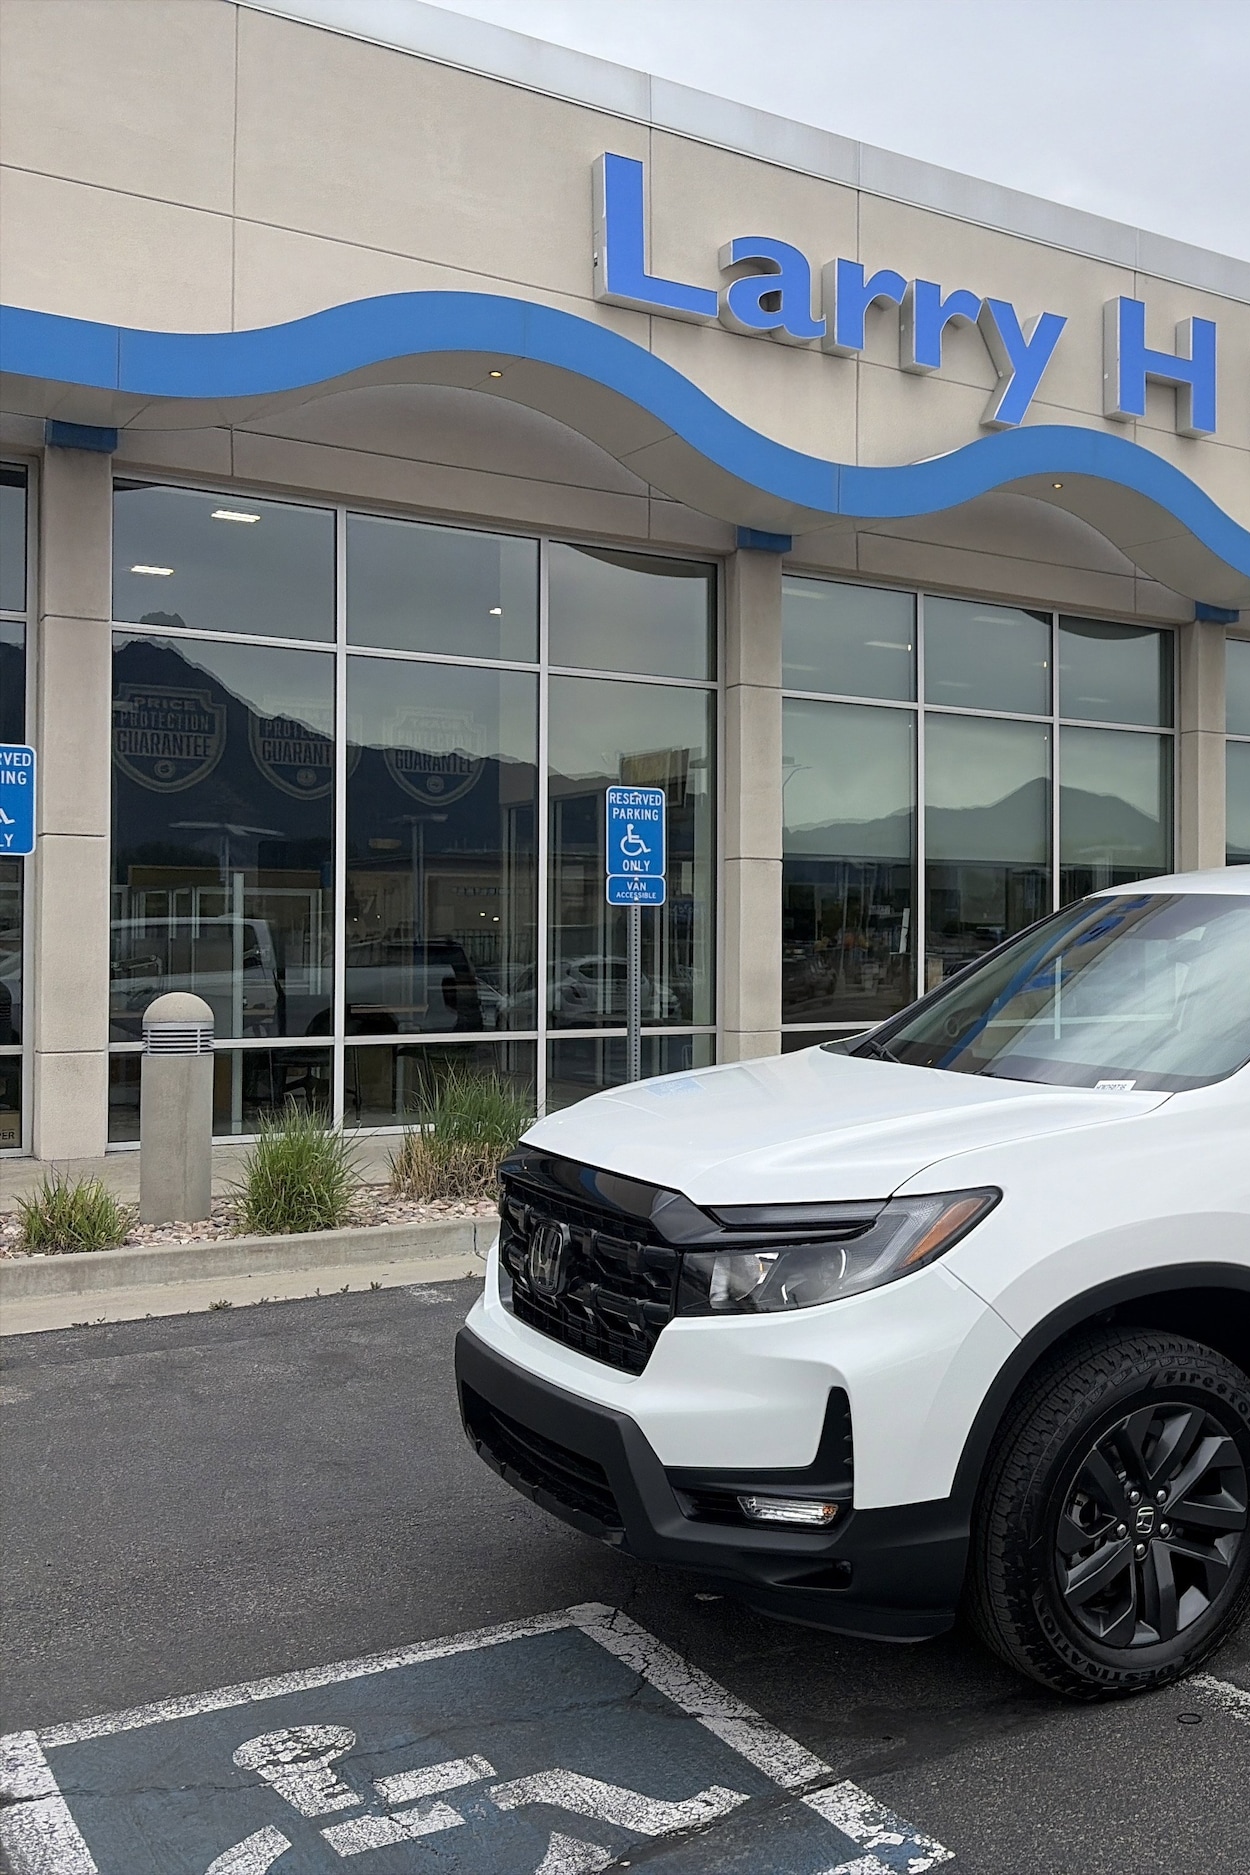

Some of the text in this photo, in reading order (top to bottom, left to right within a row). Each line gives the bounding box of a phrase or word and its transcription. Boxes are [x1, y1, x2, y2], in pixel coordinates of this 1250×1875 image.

[596, 152, 1066, 429] Larry
[1105, 295, 1217, 438] H
[134, 697, 197, 711] PRICE
[116, 731, 212, 757] GUARANTEE
[262, 740, 332, 765] GUARANT
[609, 792, 662, 806] RESERVED
[612, 808, 659, 820] PARKING
[622, 860, 651, 871] ONLY
[627, 882, 647, 891] VAN
[616, 891, 656, 899] ACCESSIBLE
